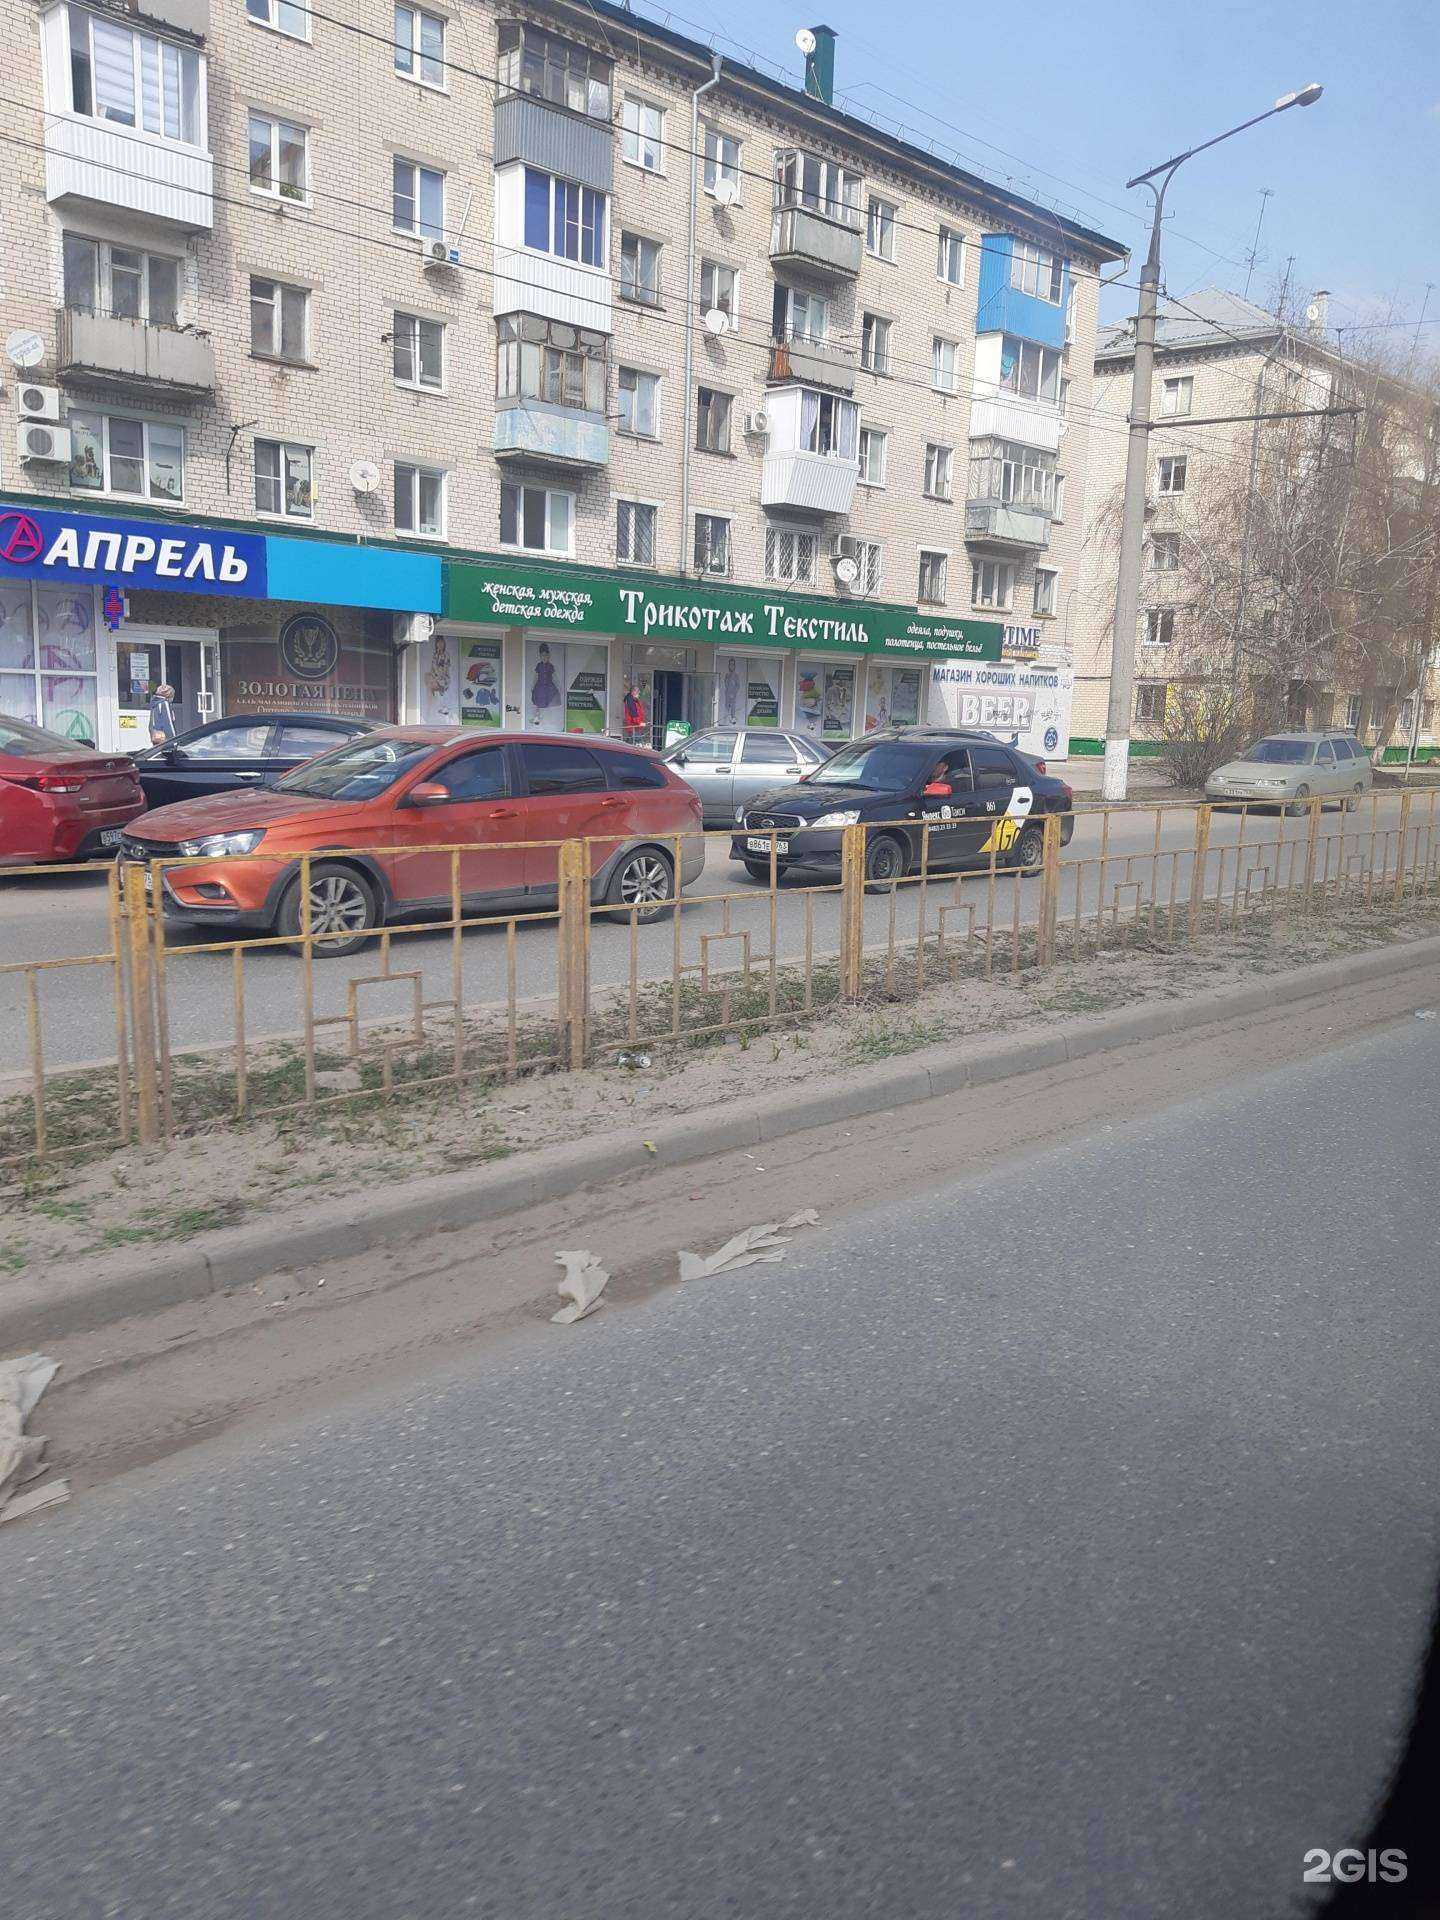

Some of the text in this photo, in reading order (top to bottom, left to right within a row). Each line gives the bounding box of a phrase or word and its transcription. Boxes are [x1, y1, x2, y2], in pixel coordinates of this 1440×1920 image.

[43, 528, 248, 582] АПРЕЛЬ
[481, 582, 593, 606] женская, мужская,
[491, 594, 584, 623] детская одежда
[619, 589, 869, 643] Трикотаж Текстиль
[906, 622, 964, 640] одеяла, подушки,
[885, 637, 925, 651] полотенца,
[926, 641, 964, 652] постельное
[933, 668, 972, 684] МАГАЗИН
[976, 670, 1015, 685] ХОРОШИХ
[1019, 673, 1059, 688] НАПИТКОВ
[238, 681, 324, 699] ЗОЛОТАЯ
[961, 695, 1031, 728] BEER
[986, 802, 996, 812] 861
